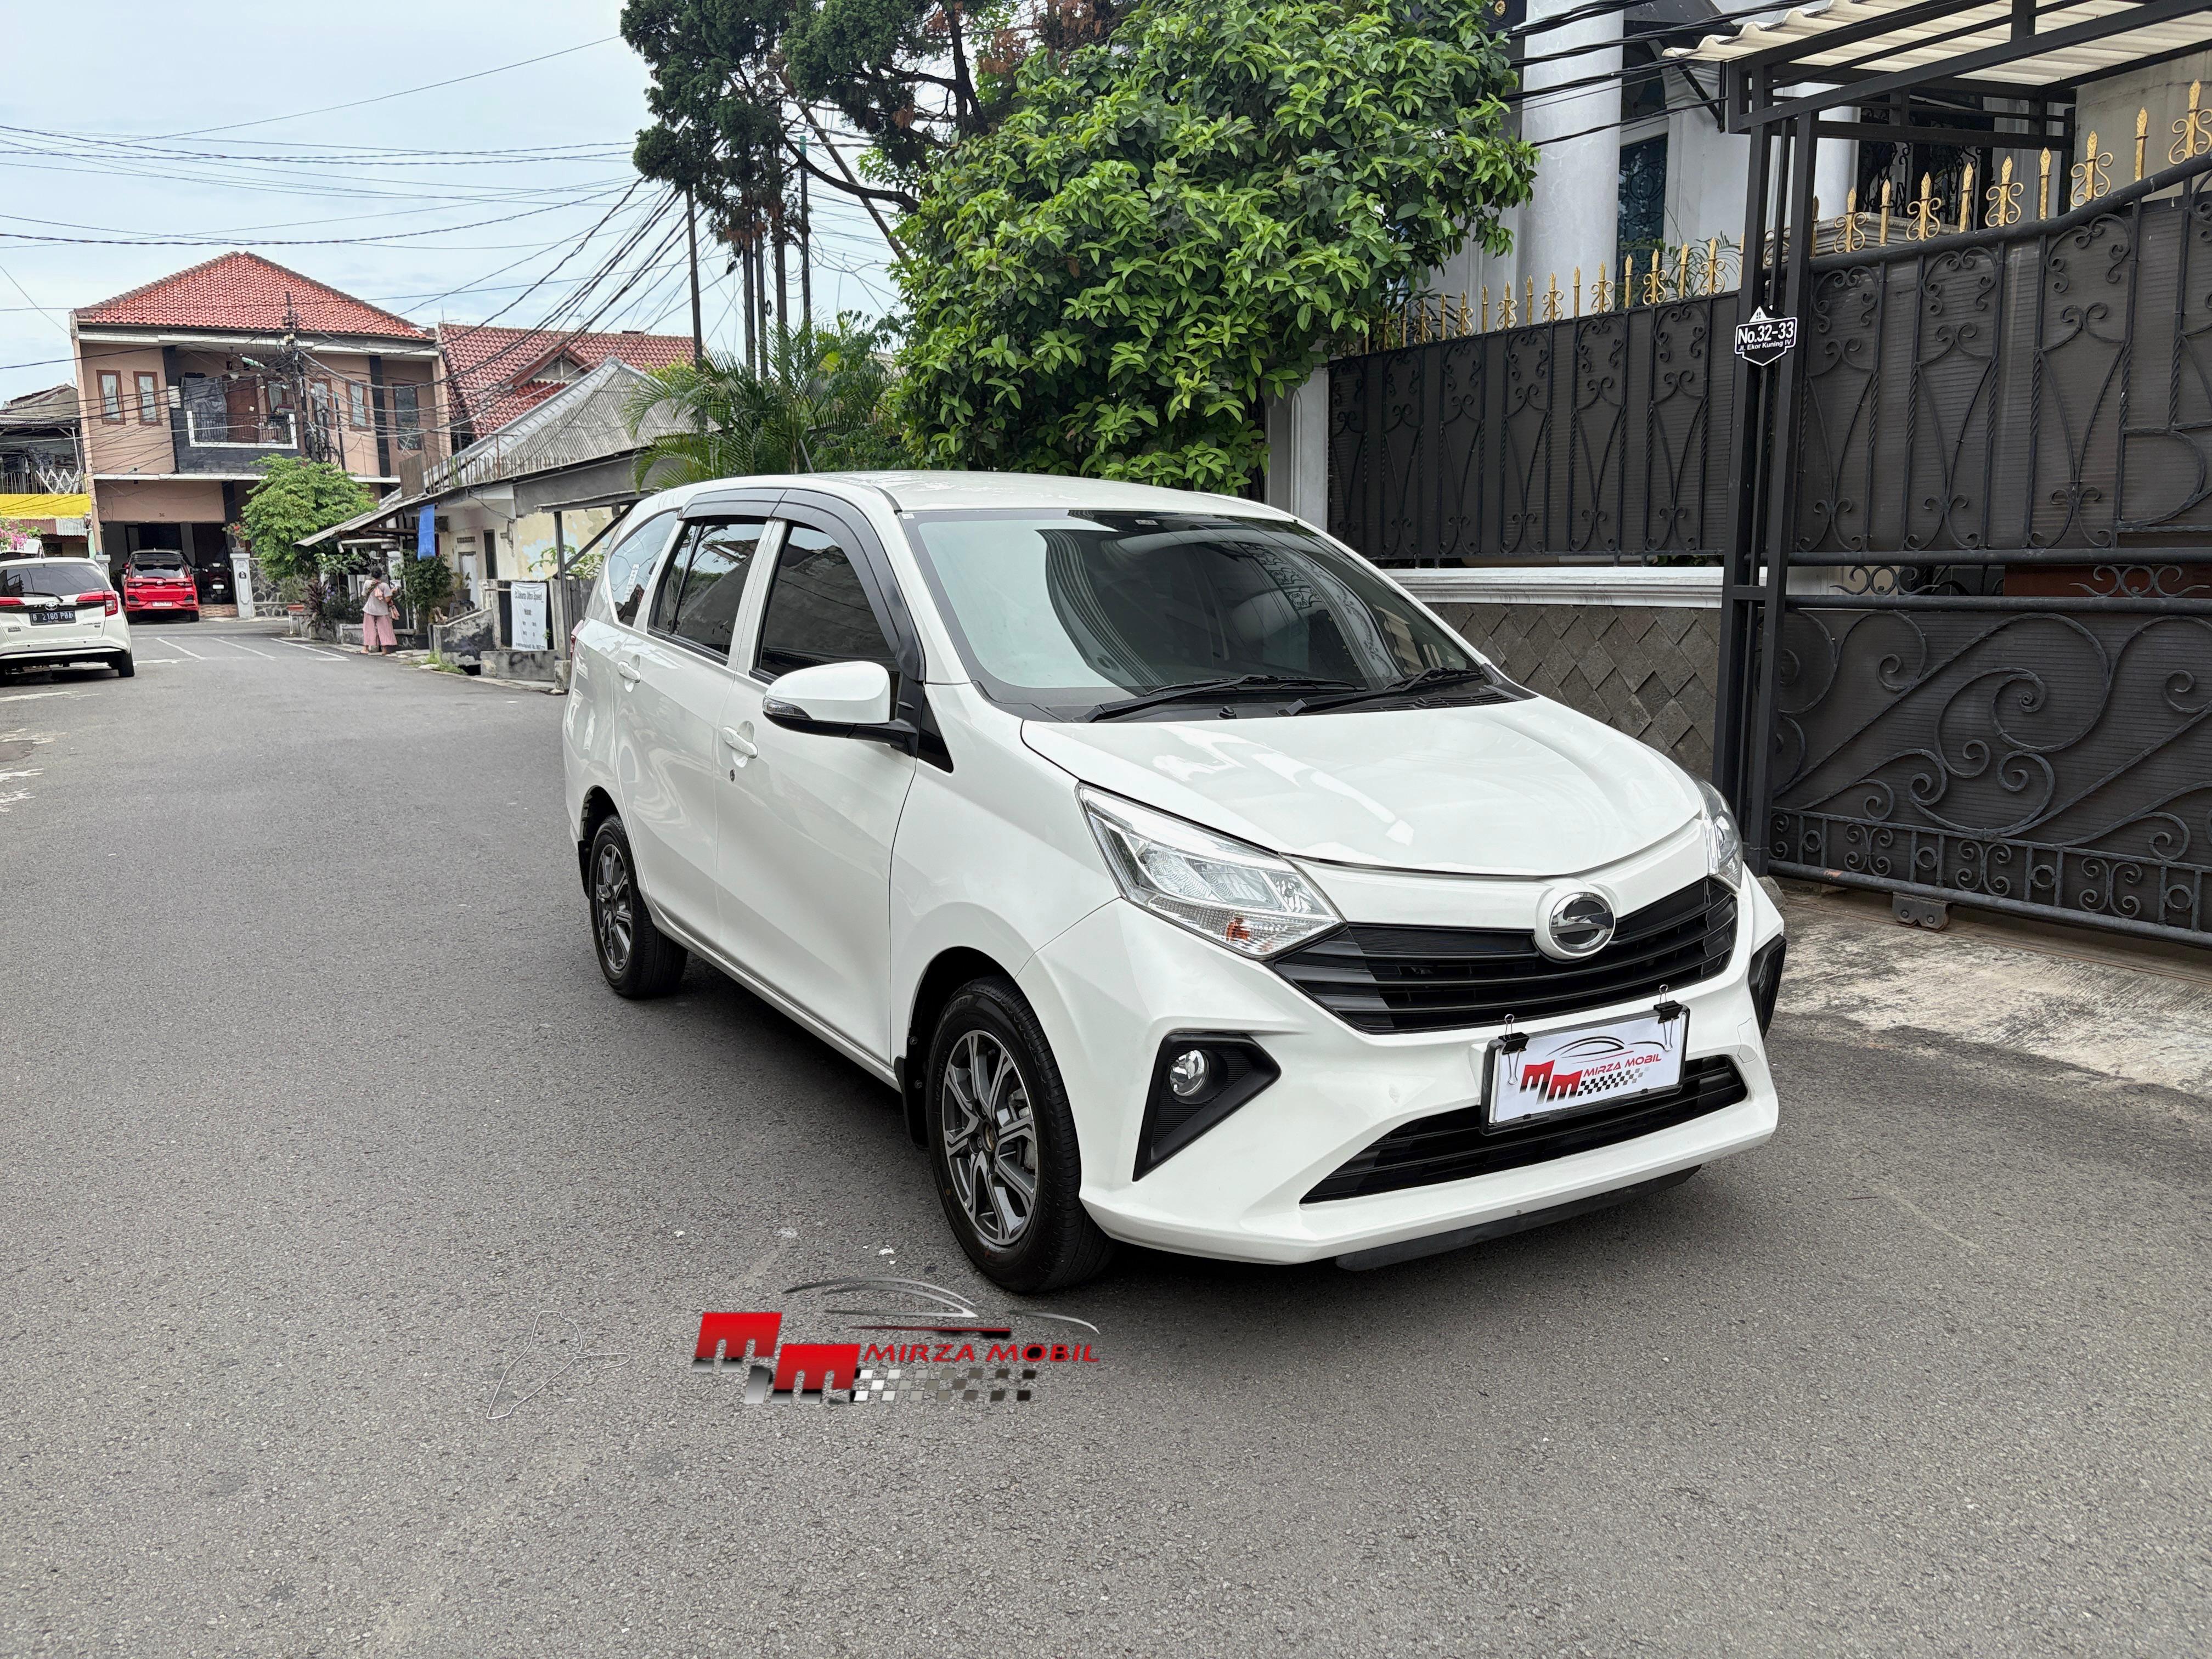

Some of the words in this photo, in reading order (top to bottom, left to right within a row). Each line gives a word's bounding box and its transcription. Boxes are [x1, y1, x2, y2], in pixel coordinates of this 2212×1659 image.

[1738, 321, 1794, 345] No.32-33
[42, 612, 58, 621] 2180
[1583, 1062, 1621, 1077] MIRZA
[1624, 1053, 1662, 1068] MOBIL
